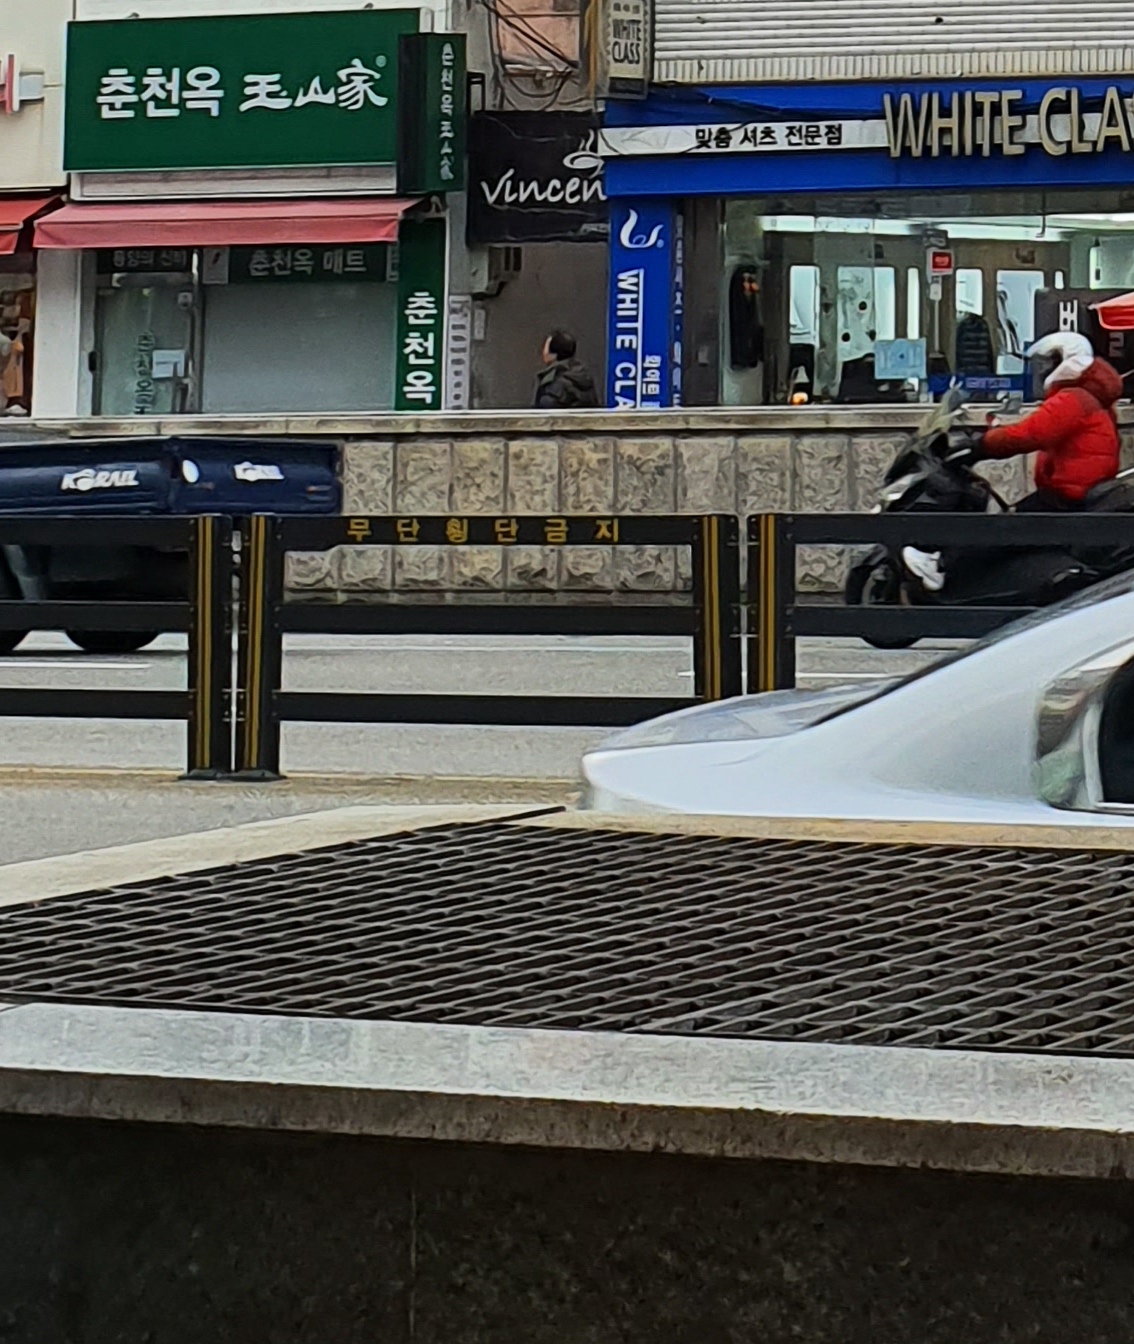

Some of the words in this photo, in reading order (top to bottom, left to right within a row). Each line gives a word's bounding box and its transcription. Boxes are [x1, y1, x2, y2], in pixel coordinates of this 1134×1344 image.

[96, 66, 225, 120] 춘천옥
[695, 125, 733, 147] 맞춤
[738, 125, 778, 146] 셔츠
[785, 122, 843, 146] 전문점
[883, 88, 1025, 159] WHITE
[249, 249, 315, 278] 춘천옥
[616, 269, 640, 350] WHITE
[402, 291, 438, 404] 춘천옥
